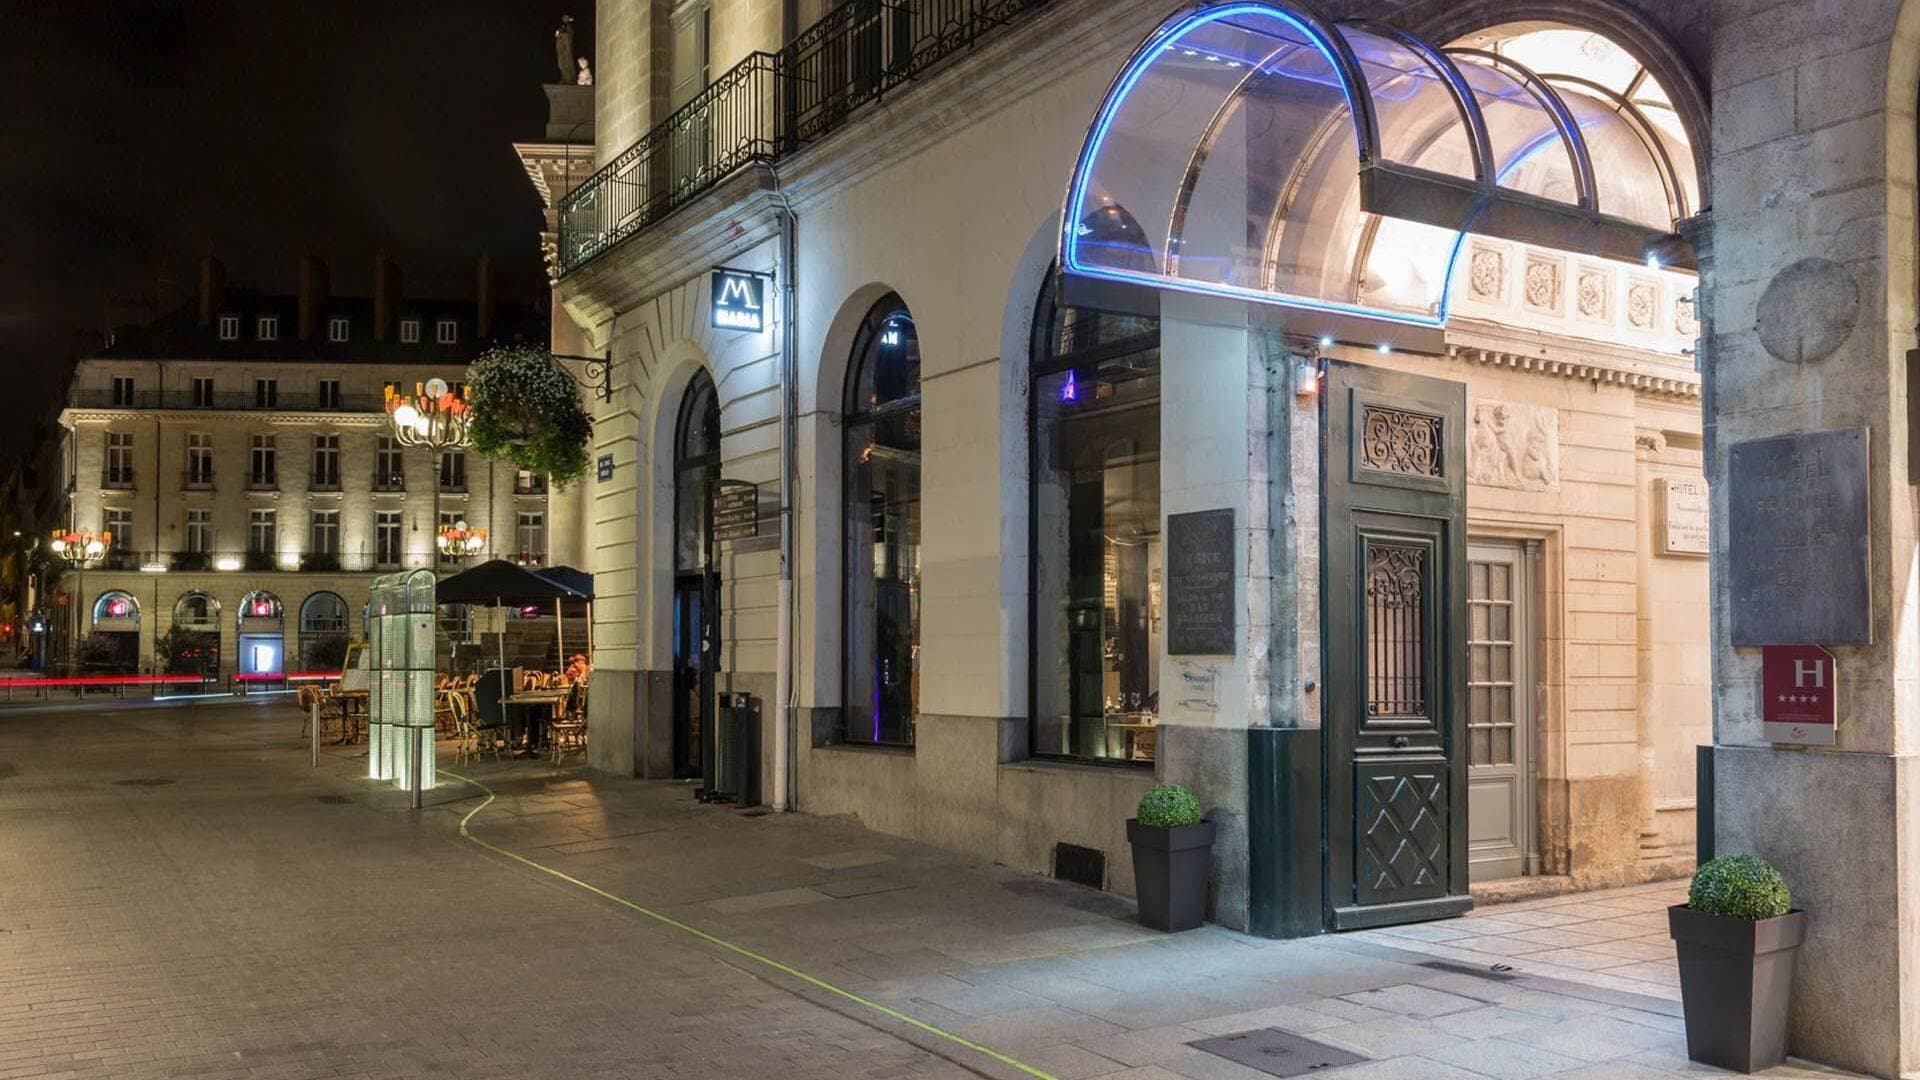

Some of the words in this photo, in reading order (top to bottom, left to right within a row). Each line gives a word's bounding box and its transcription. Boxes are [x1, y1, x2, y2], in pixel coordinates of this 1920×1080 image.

[716, 277, 761, 309] M
[1760, 459, 1832, 482] HTEL
[1793, 659, 1827, 688] H
